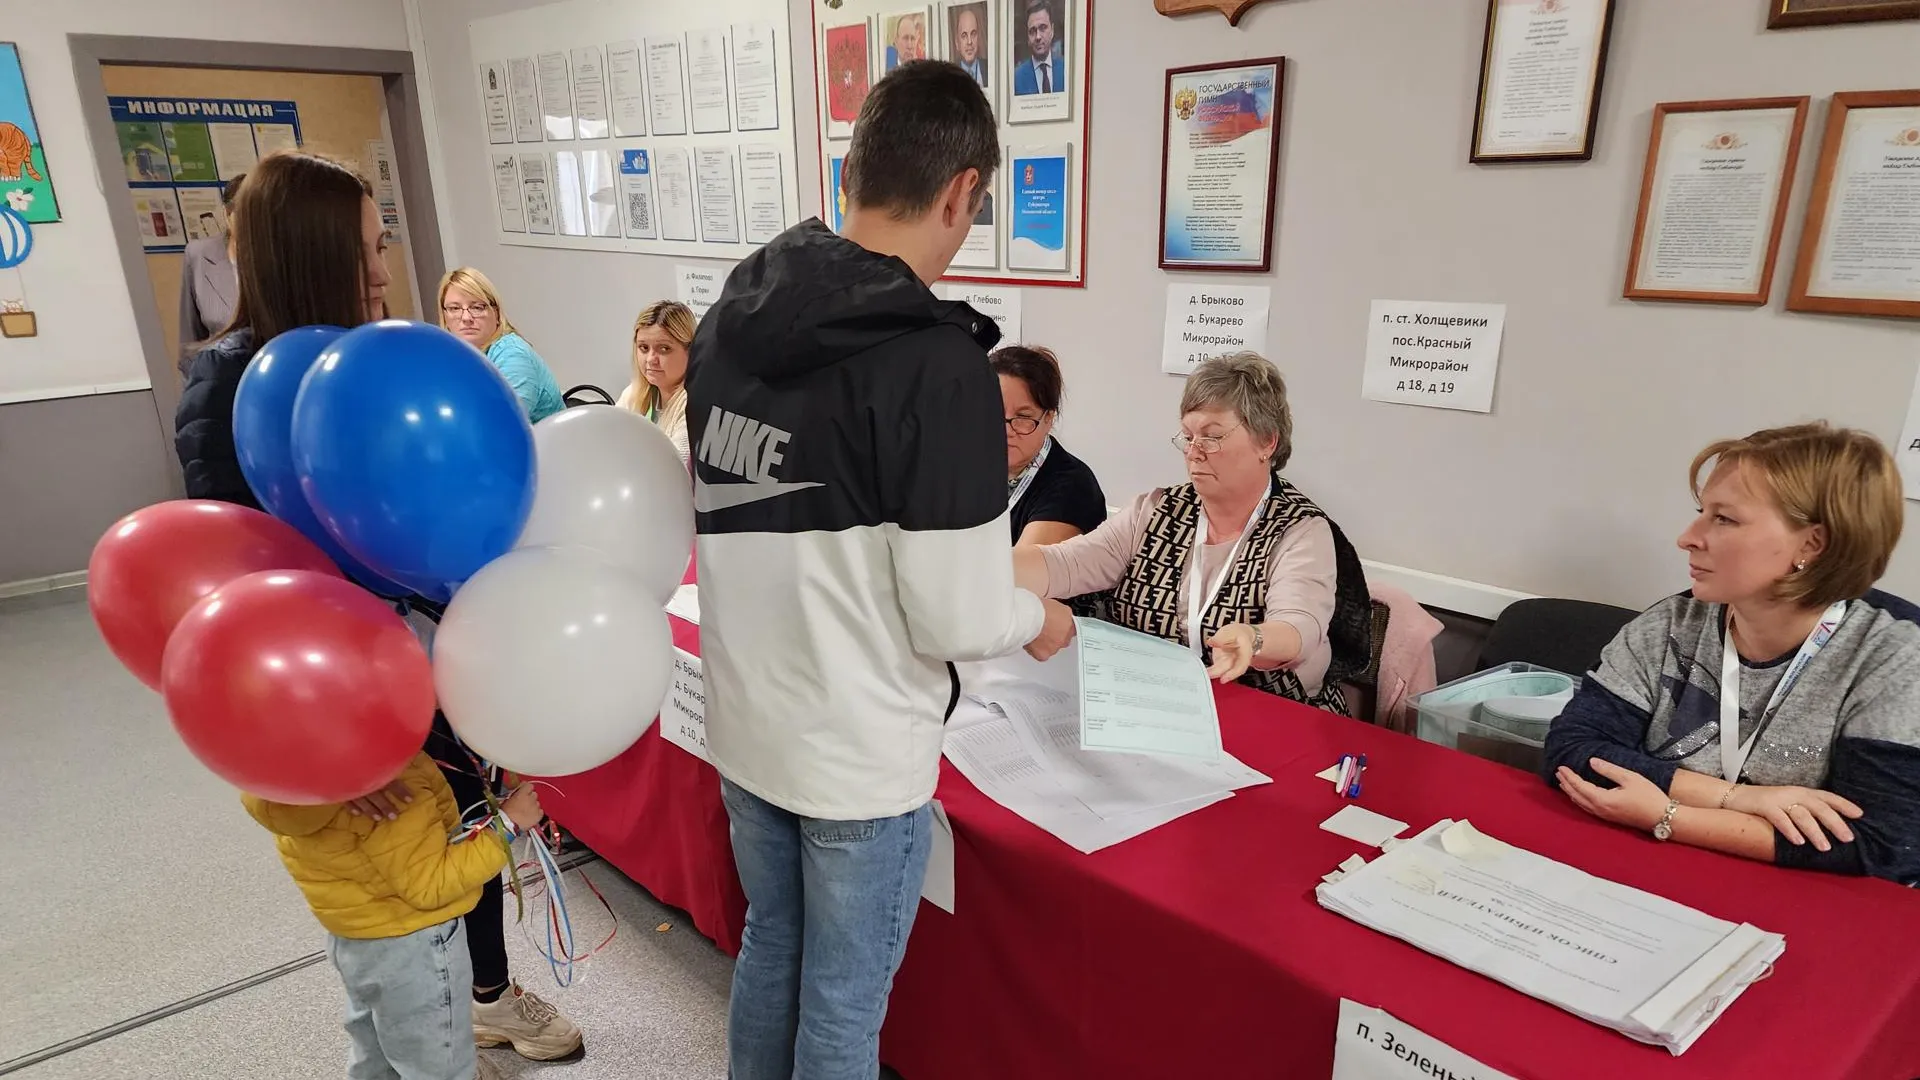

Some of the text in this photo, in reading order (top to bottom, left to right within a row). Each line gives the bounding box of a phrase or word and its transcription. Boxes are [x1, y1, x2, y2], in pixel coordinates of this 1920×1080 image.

[1199, 80, 1270, 93] ГОСУДАРСТВЕННЫЙ
[1199, 95, 1217, 104] ГИМН
[127, 100, 274, 118] ИНФОРМАЦИЯ
[973, 294, 1002, 305] Глебово
[1189, 294, 1244, 306] д. Брыково
[1186, 313, 1244, 327] д. Букарево
[1382, 313, 1488, 328] п. ст. Холщевики
[1182, 332, 1244, 346] Микрорайон
[1392, 336, 1472, 350] пос.Красный
[1188, 354, 1195, 363] д
[1389, 356, 1469, 372] Микрорайон
[1396, 379, 1455, 394] д 18, д 19
[699, 404, 792, 484] NIKE
[674, 659, 681, 672] д.
[675, 680, 682, 692] д.
[1436, 888, 1545, 936] ИЗБИРАТЕЛЕЙ
[1547, 932, 1618, 965] СПИСОК
[1356, 1022, 1477, 1080] п. Зелен
